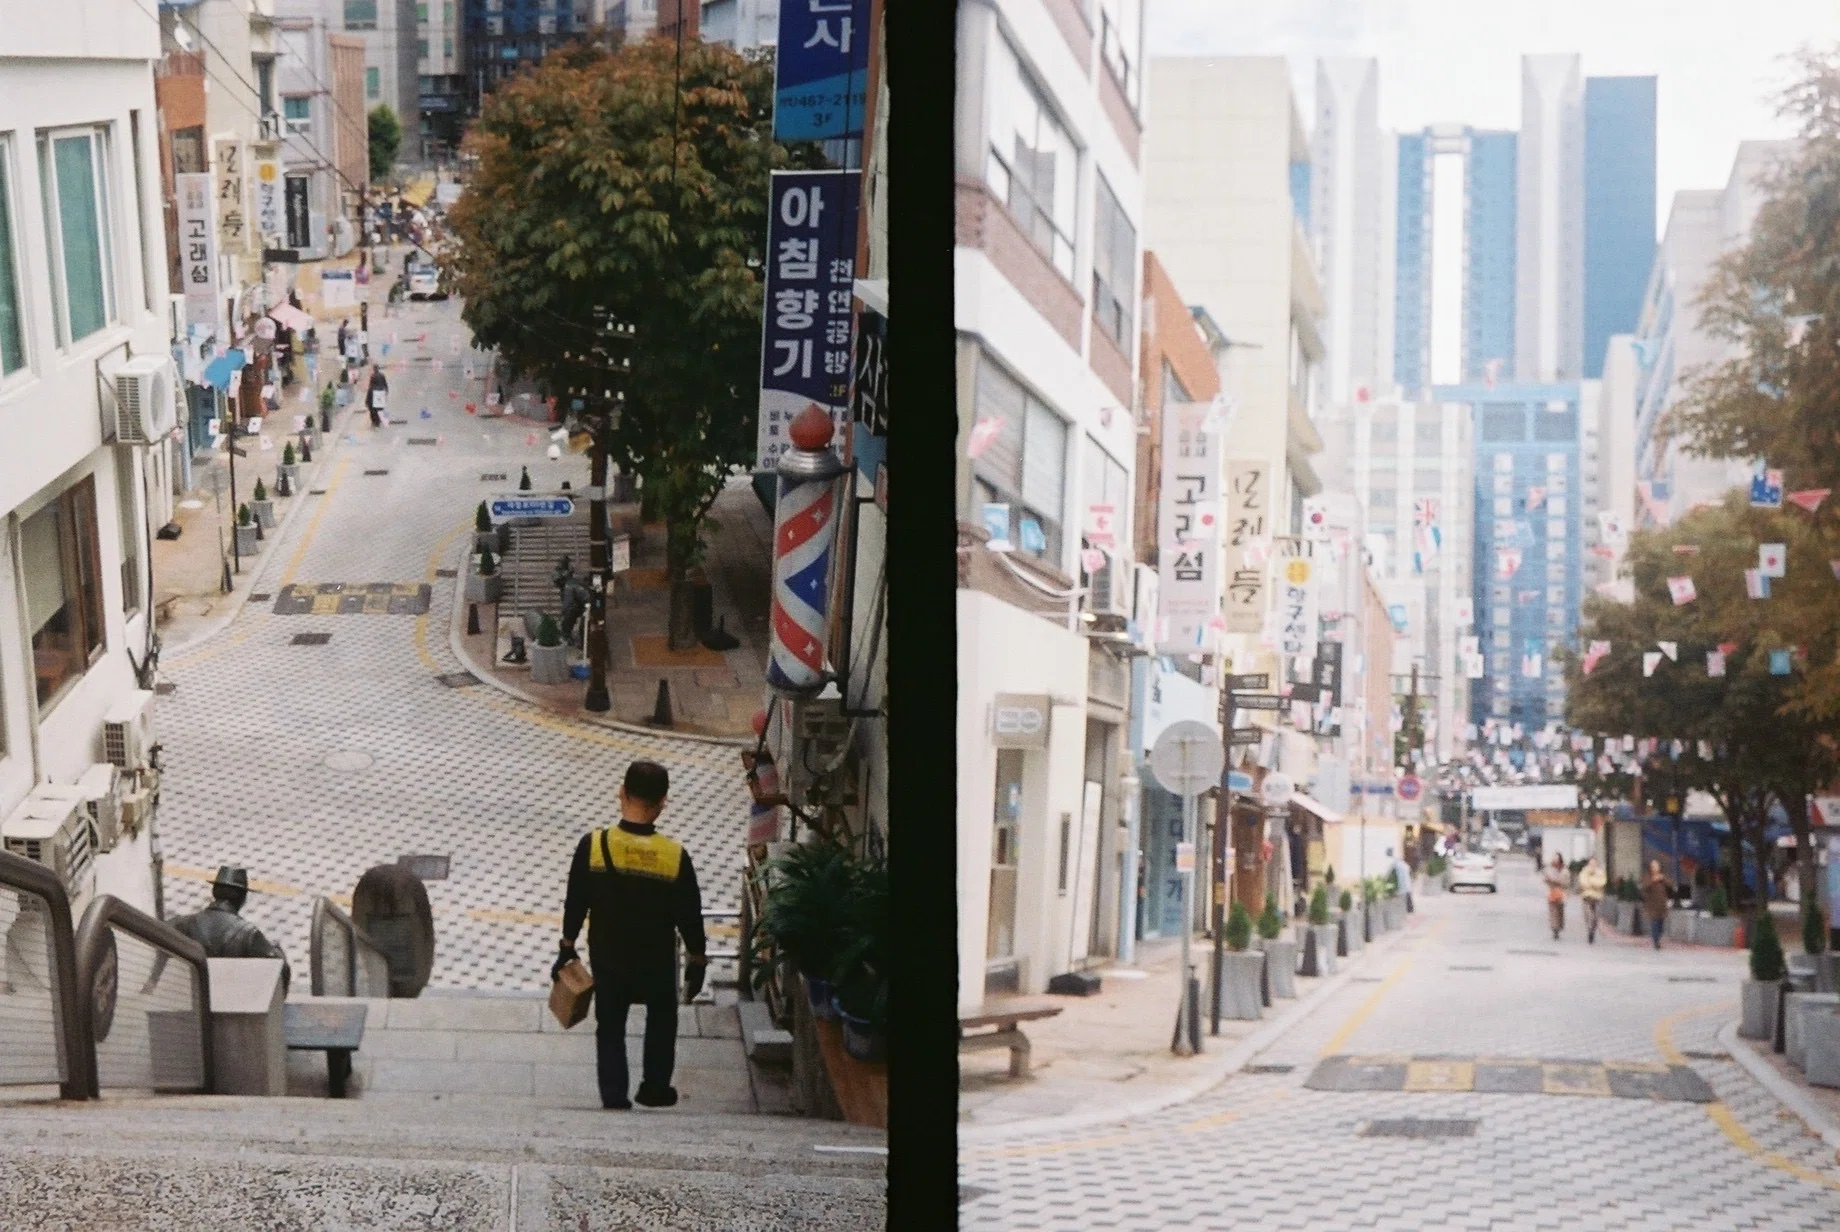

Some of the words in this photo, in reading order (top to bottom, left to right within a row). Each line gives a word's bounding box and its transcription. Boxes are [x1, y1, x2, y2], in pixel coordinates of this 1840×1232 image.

[813, 112, 831, 127] 3F
[187, 219, 208, 283] 고래섬
[773, 186, 825, 379] 아침향기
